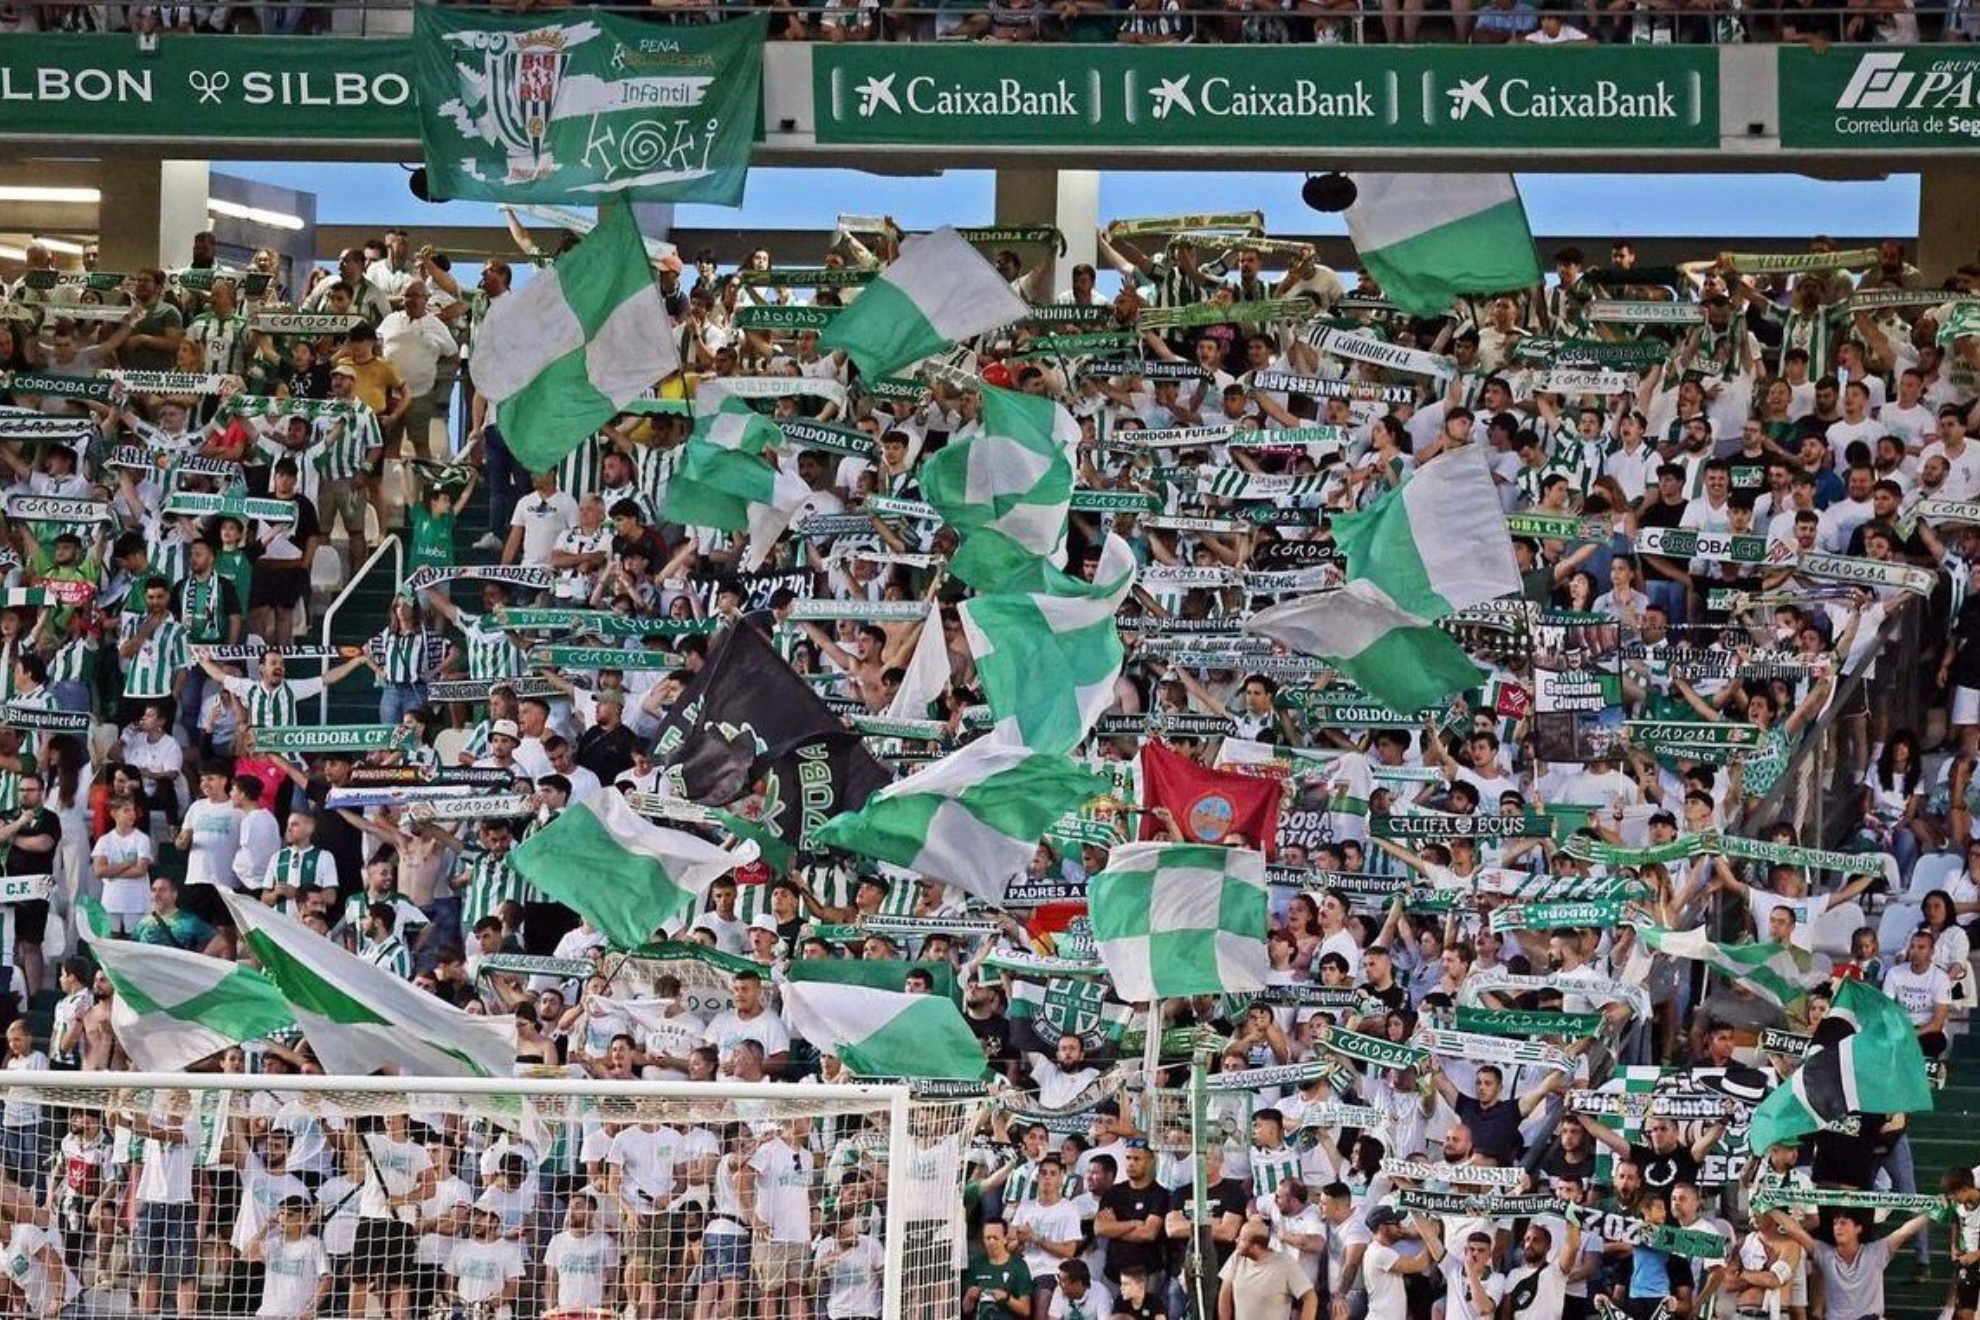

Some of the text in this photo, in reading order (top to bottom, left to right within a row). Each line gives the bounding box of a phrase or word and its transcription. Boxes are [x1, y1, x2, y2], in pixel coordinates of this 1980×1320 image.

[243, 71, 419, 106] SILBO
[622, 82, 691, 104] Infantil
[906, 75, 1078, 116] CaixaBank
[1201, 77, 1375, 117] CaixaBank
[1499, 79, 1677, 118] CaixaBank
[1835, 115, 1919, 134] Correduría
[1923, 117, 1944, 133] de
[1544, 680, 1601, 696] Sección
[365, 729, 388, 744] CF
[1276, 810, 1332, 832] DOBA
[1477, 817, 1525, 836] BOYS
[1274, 828, 1334, 849] ATICS
[5, 881, 32, 896] C.F.
[1008, 886, 1080, 899] PADRES A
